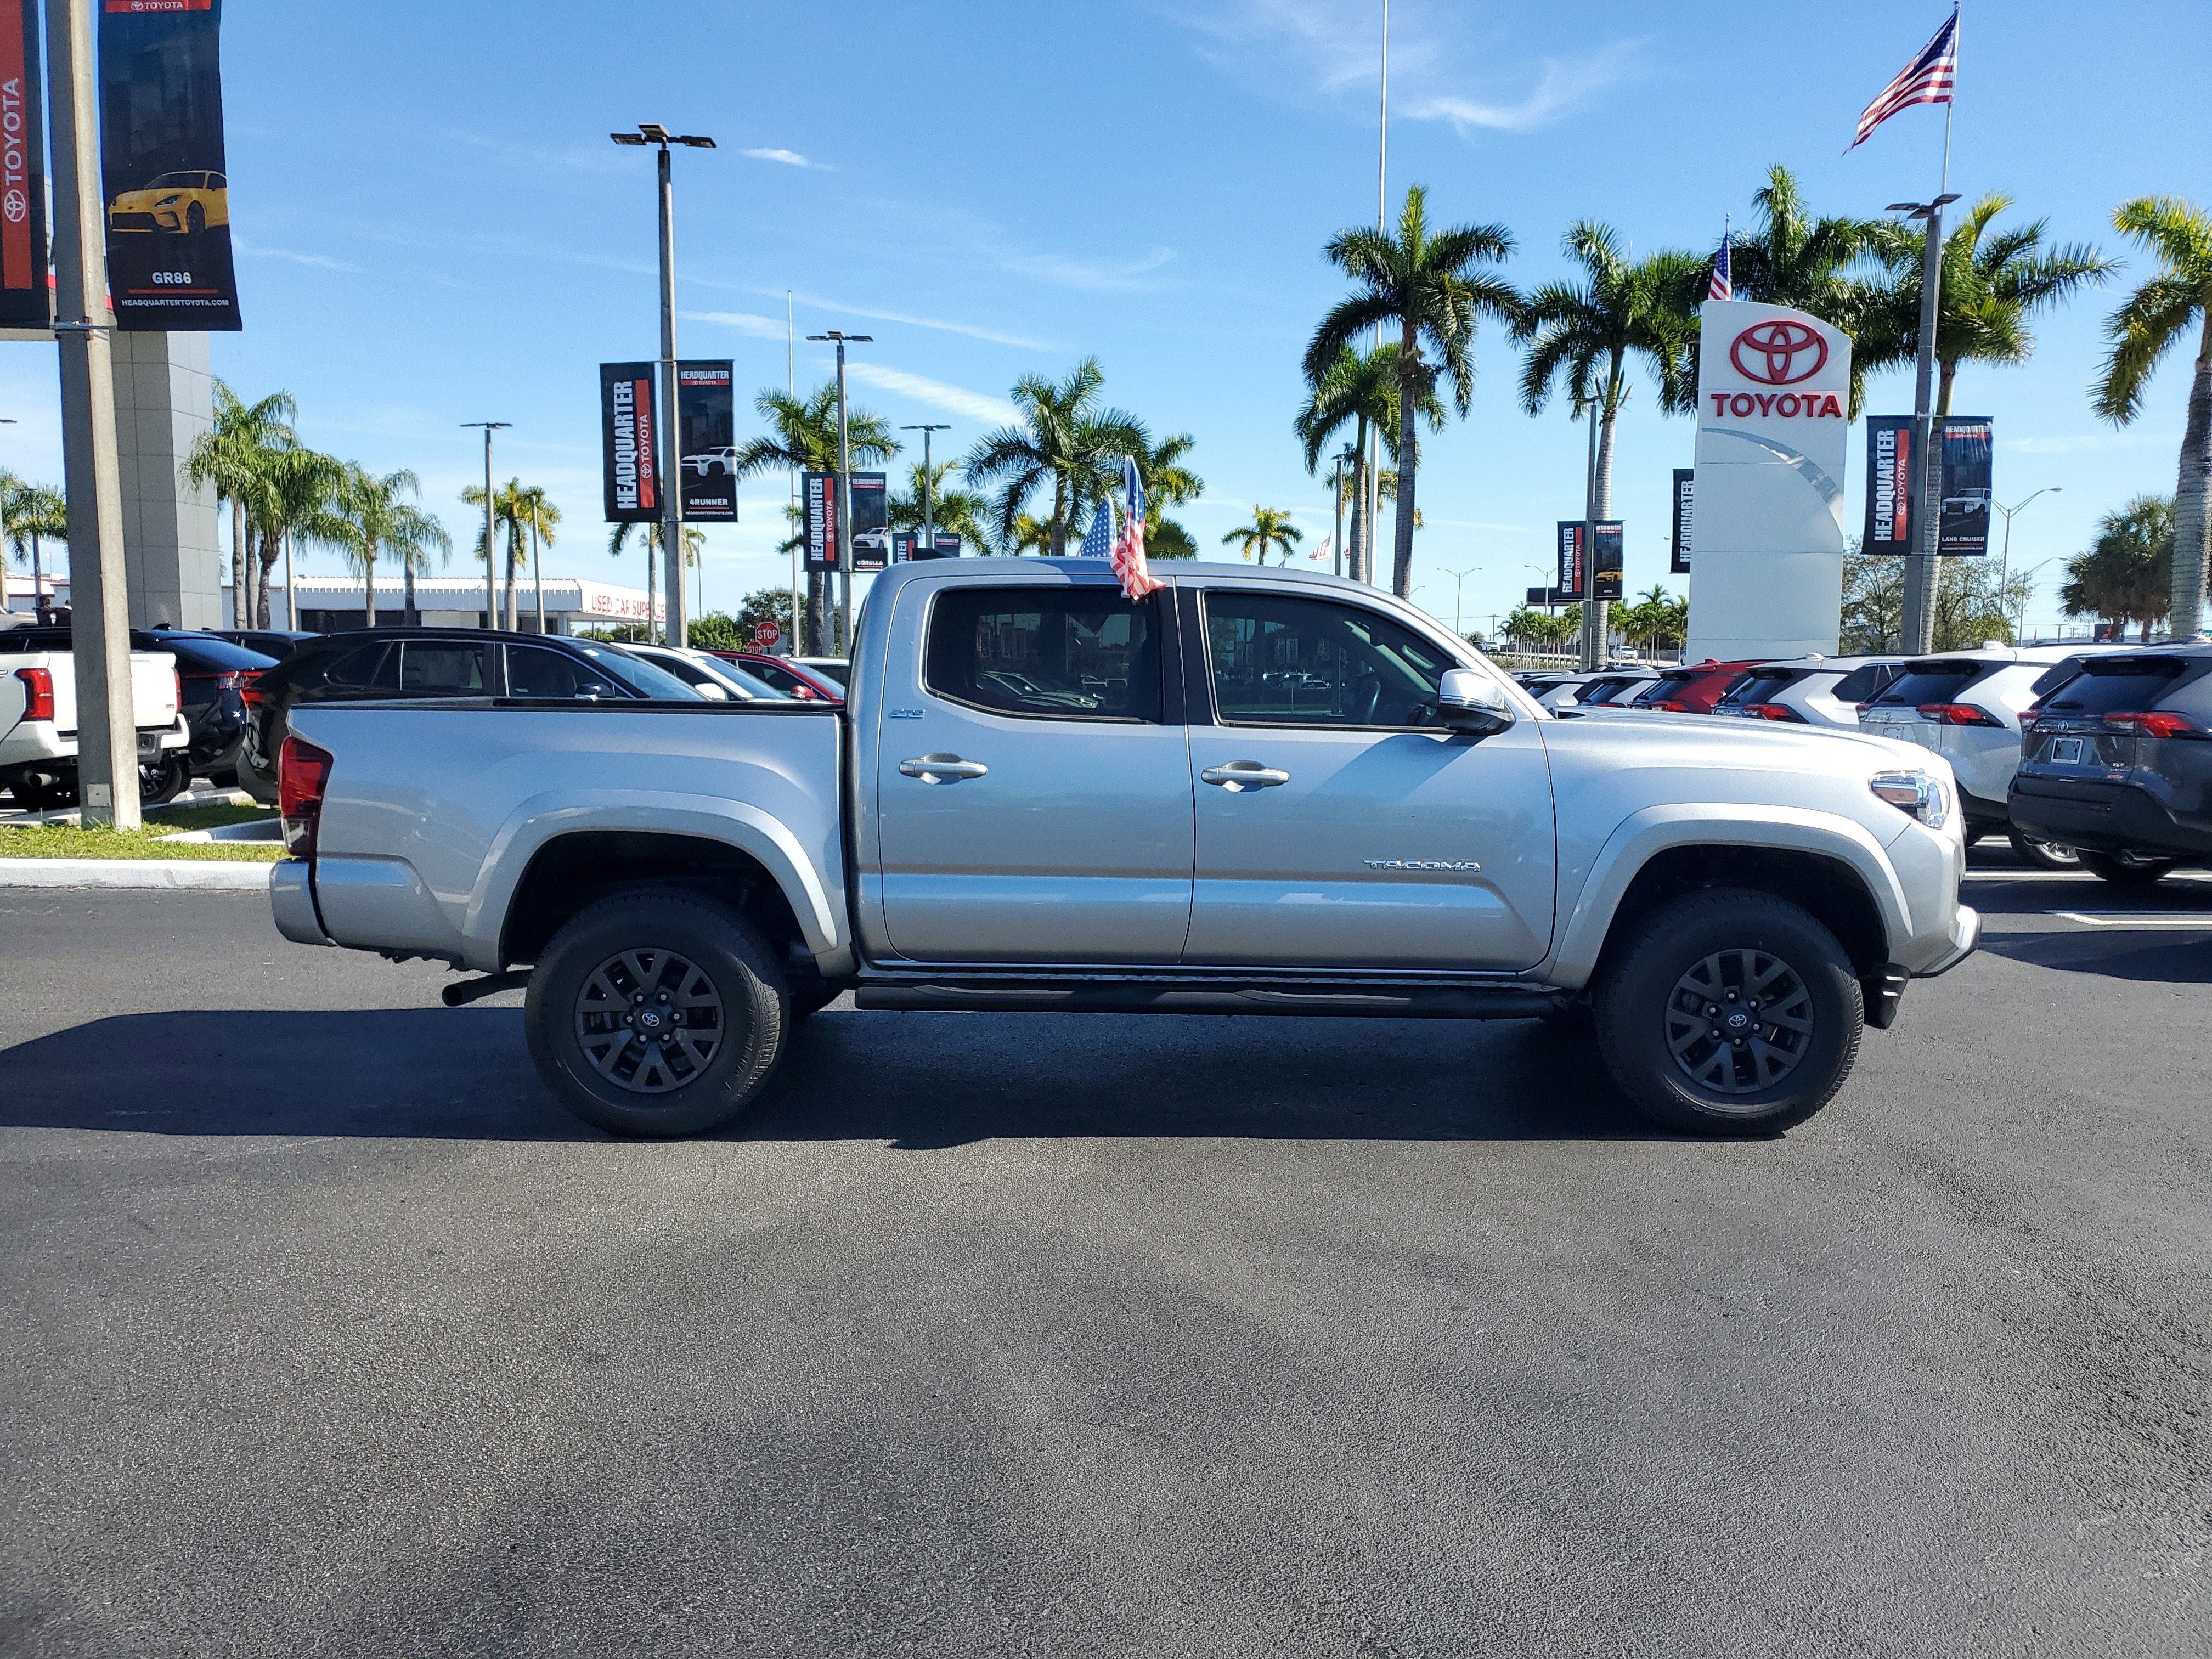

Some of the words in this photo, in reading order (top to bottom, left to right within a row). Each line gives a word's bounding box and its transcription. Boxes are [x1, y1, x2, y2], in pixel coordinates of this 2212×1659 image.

[144, 1, 183, 9] TOYOTA
[2, 78, 22, 186] TOYOTA
[152, 272, 191, 284] GR86
[681, 370, 729, 380] HEADQUARTER
[1710, 393, 1842, 418] TOYOTA
[613, 381, 638, 509] HEADQUARTER
[639, 414, 651, 462] TOYOTA
[1874, 430, 1895, 541] HEADQUARTER
[1897, 459, 1906, 500] TOYOTA
[810, 478, 824, 561] HEADQUARTER
[1680, 481, 1694, 562] HEADQUARTER
[1562, 527, 1575, 592] HEADQUARTER
[591, 594, 612, 613] USED
[615, 597, 630, 616] CAR
[748, 646, 762, 654] STOP
[757, 630, 777, 639] STOP
[1363, 859, 1481, 872] TACOMA
